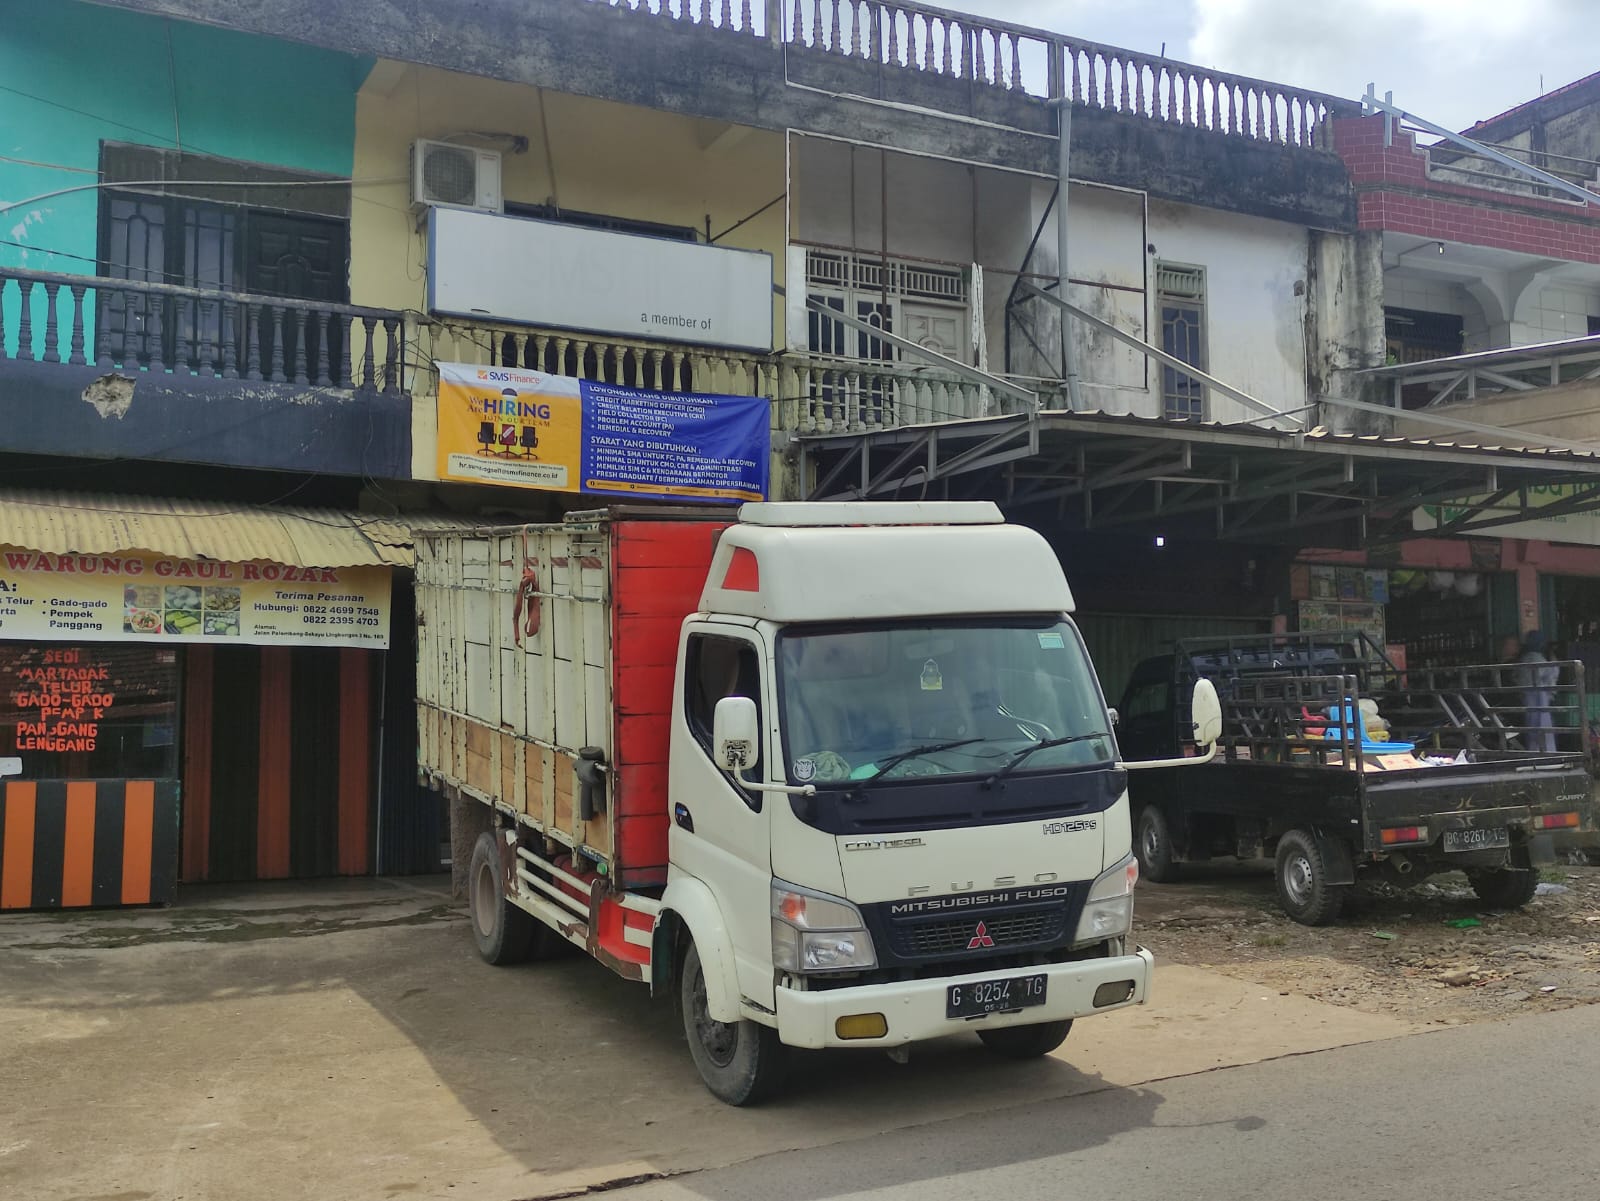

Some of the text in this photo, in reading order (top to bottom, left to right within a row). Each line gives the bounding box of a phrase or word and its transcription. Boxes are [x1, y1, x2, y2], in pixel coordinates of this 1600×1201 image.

[641, 313, 712, 330] a member of
[589, 385, 637, 398] LOWONGAN
[638, 392, 661, 400] YANG
[483, 398, 551, 419] HIRING
[596, 395, 619, 405] CREDIT
[620, 398, 659, 409] MARKETING
[660, 403, 686, 412] OFFICER
[597, 402, 620, 411] CREDIT
[621, 405, 653, 415] RELATION
[654, 409, 688, 419] EXECUTIVE
[484, 414, 551, 428] JOIN OUR TEAM
[597, 409, 617, 417] FIELD
[618, 412, 655, 422] COLLECTOR
[597, 416, 675, 431] PROBLEM ACCOUNT (PA)
[597, 423, 631, 433] REMEDIAL
[638, 428, 672, 438] RECOVERY
[590, 436, 621, 446] SYARAT
[622, 439, 645, 448] YANG
[646, 441, 698, 454] DIBUTUHKAN
[596, 447, 626, 457] MINIMAL
[627, 450, 642, 459] SMA
[642, 451, 665, 461] UNTUK
[727, 459, 757, 468] RECOVERY
[596, 455, 626, 464] MINIMAL
[636, 459, 659, 467] UNTUK
[695, 464, 742, 473] ADMINISTRASI
[596, 463, 627, 472] MEMILIKI
[652, 468, 692, 478] KENDARAAN
[693, 471, 728, 479] BERMOTOR
[596, 470, 618, 479] FRESH
[618, 472, 654, 481] GRADUATE
[658, 475, 715, 486] BERPENGALAMAN
[5, 553, 338, 583] WARUNG GAUL ROZAK
[6, 597, 34, 605] Telur
[50, 598, 108, 609] Gado-gado
[275, 591, 364, 603] Terima Pesanan
[50, 609, 93, 619] Pempek
[254, 603, 379, 616] Hubungi: 0822 4699 7548
[49, 620, 103, 631] Panggang
[303, 615, 379, 626] 0822 2395 4703
[18, 667, 109, 681] MARTABAK
[40, 680, 93, 694] TELUR
[16, 691, 113, 707] GADO-GADO
[16, 737, 96, 752] LENGGANG
[1556, 793, 1586, 801] CARRY
[884, 838, 926, 849] DIESEL
[1463, 829, 1486, 843] 8267
[907, 872, 1059, 897] FUSO
[891, 887, 1068, 914] MITSUBISHI FUSO
[952, 977, 1043, 1006] G 8254 TG
